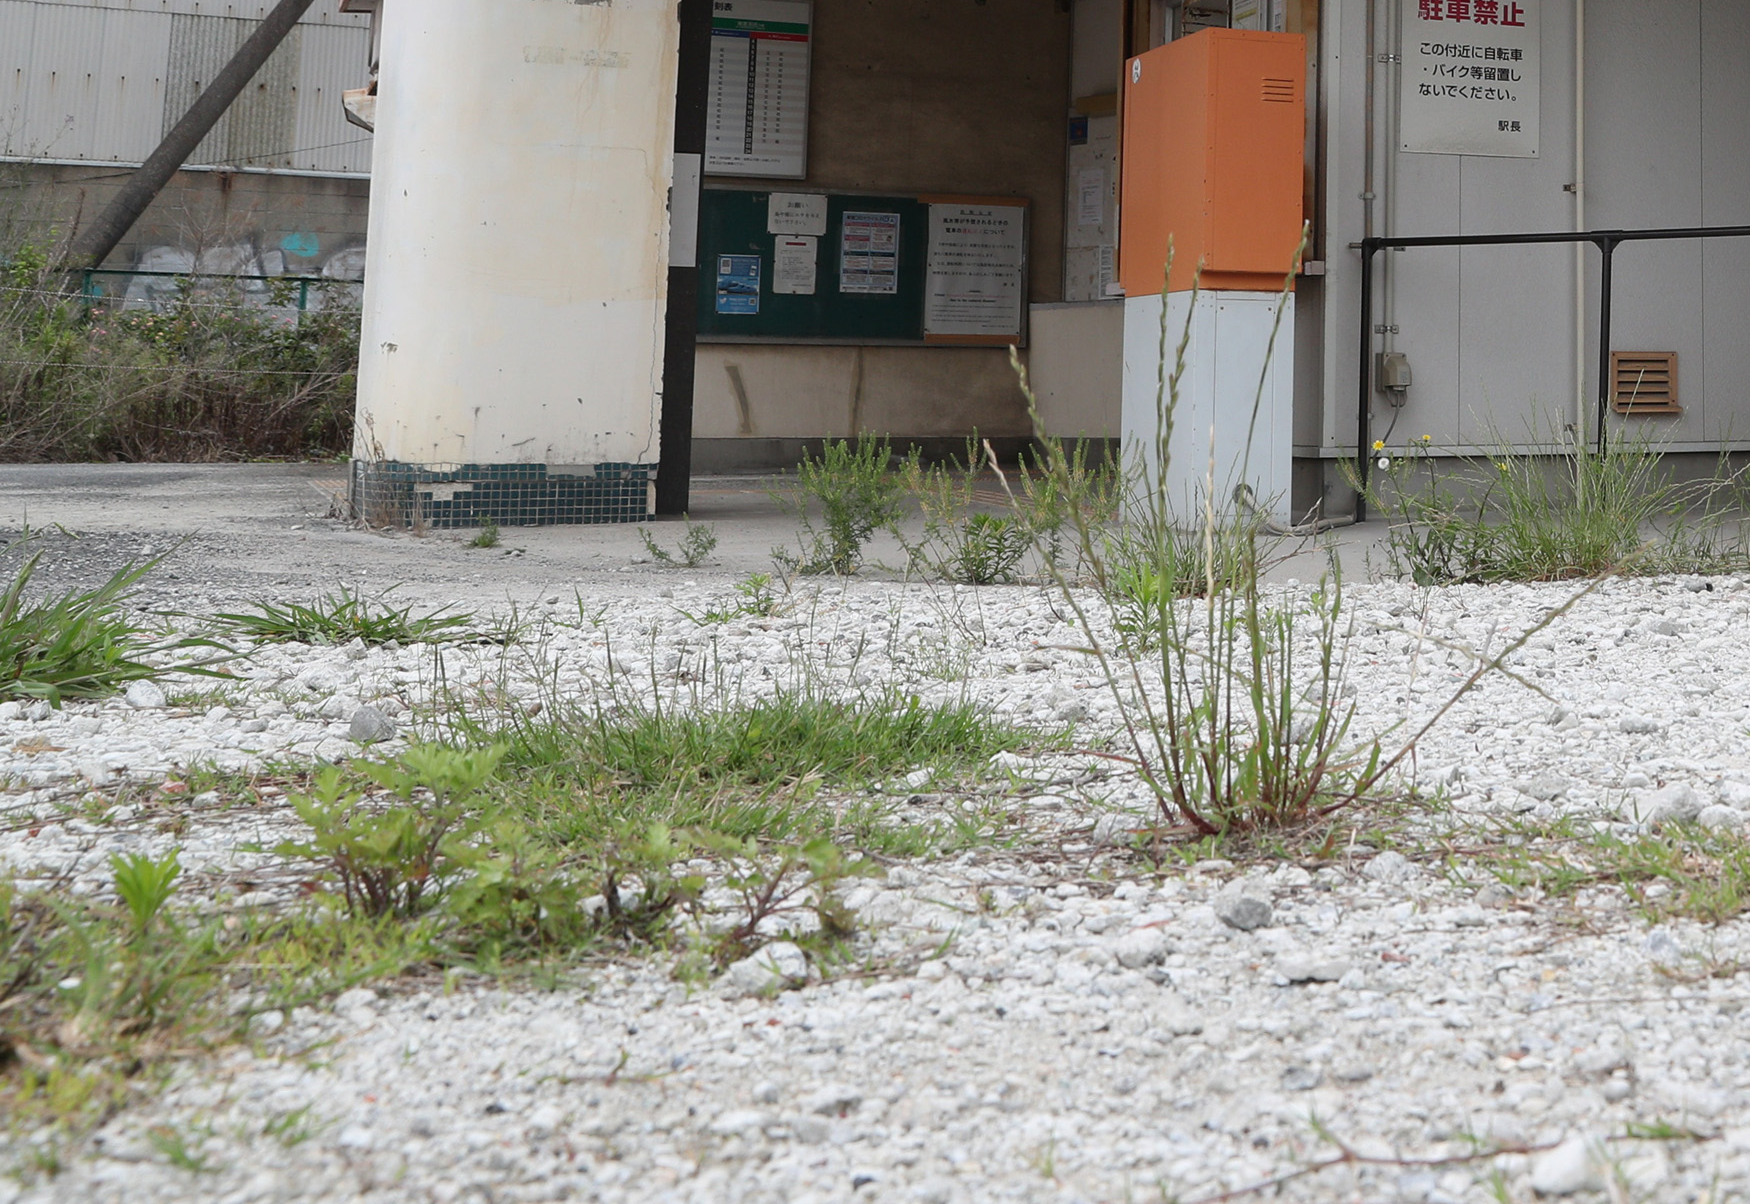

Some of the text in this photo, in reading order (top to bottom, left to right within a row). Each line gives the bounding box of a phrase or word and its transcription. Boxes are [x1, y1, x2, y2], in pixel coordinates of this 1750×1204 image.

[1420, 42, 1523, 62] この付近に自転車
[1419, 83, 1517, 102] ないでください。
[1498, 120, 1521, 133] 駅長
